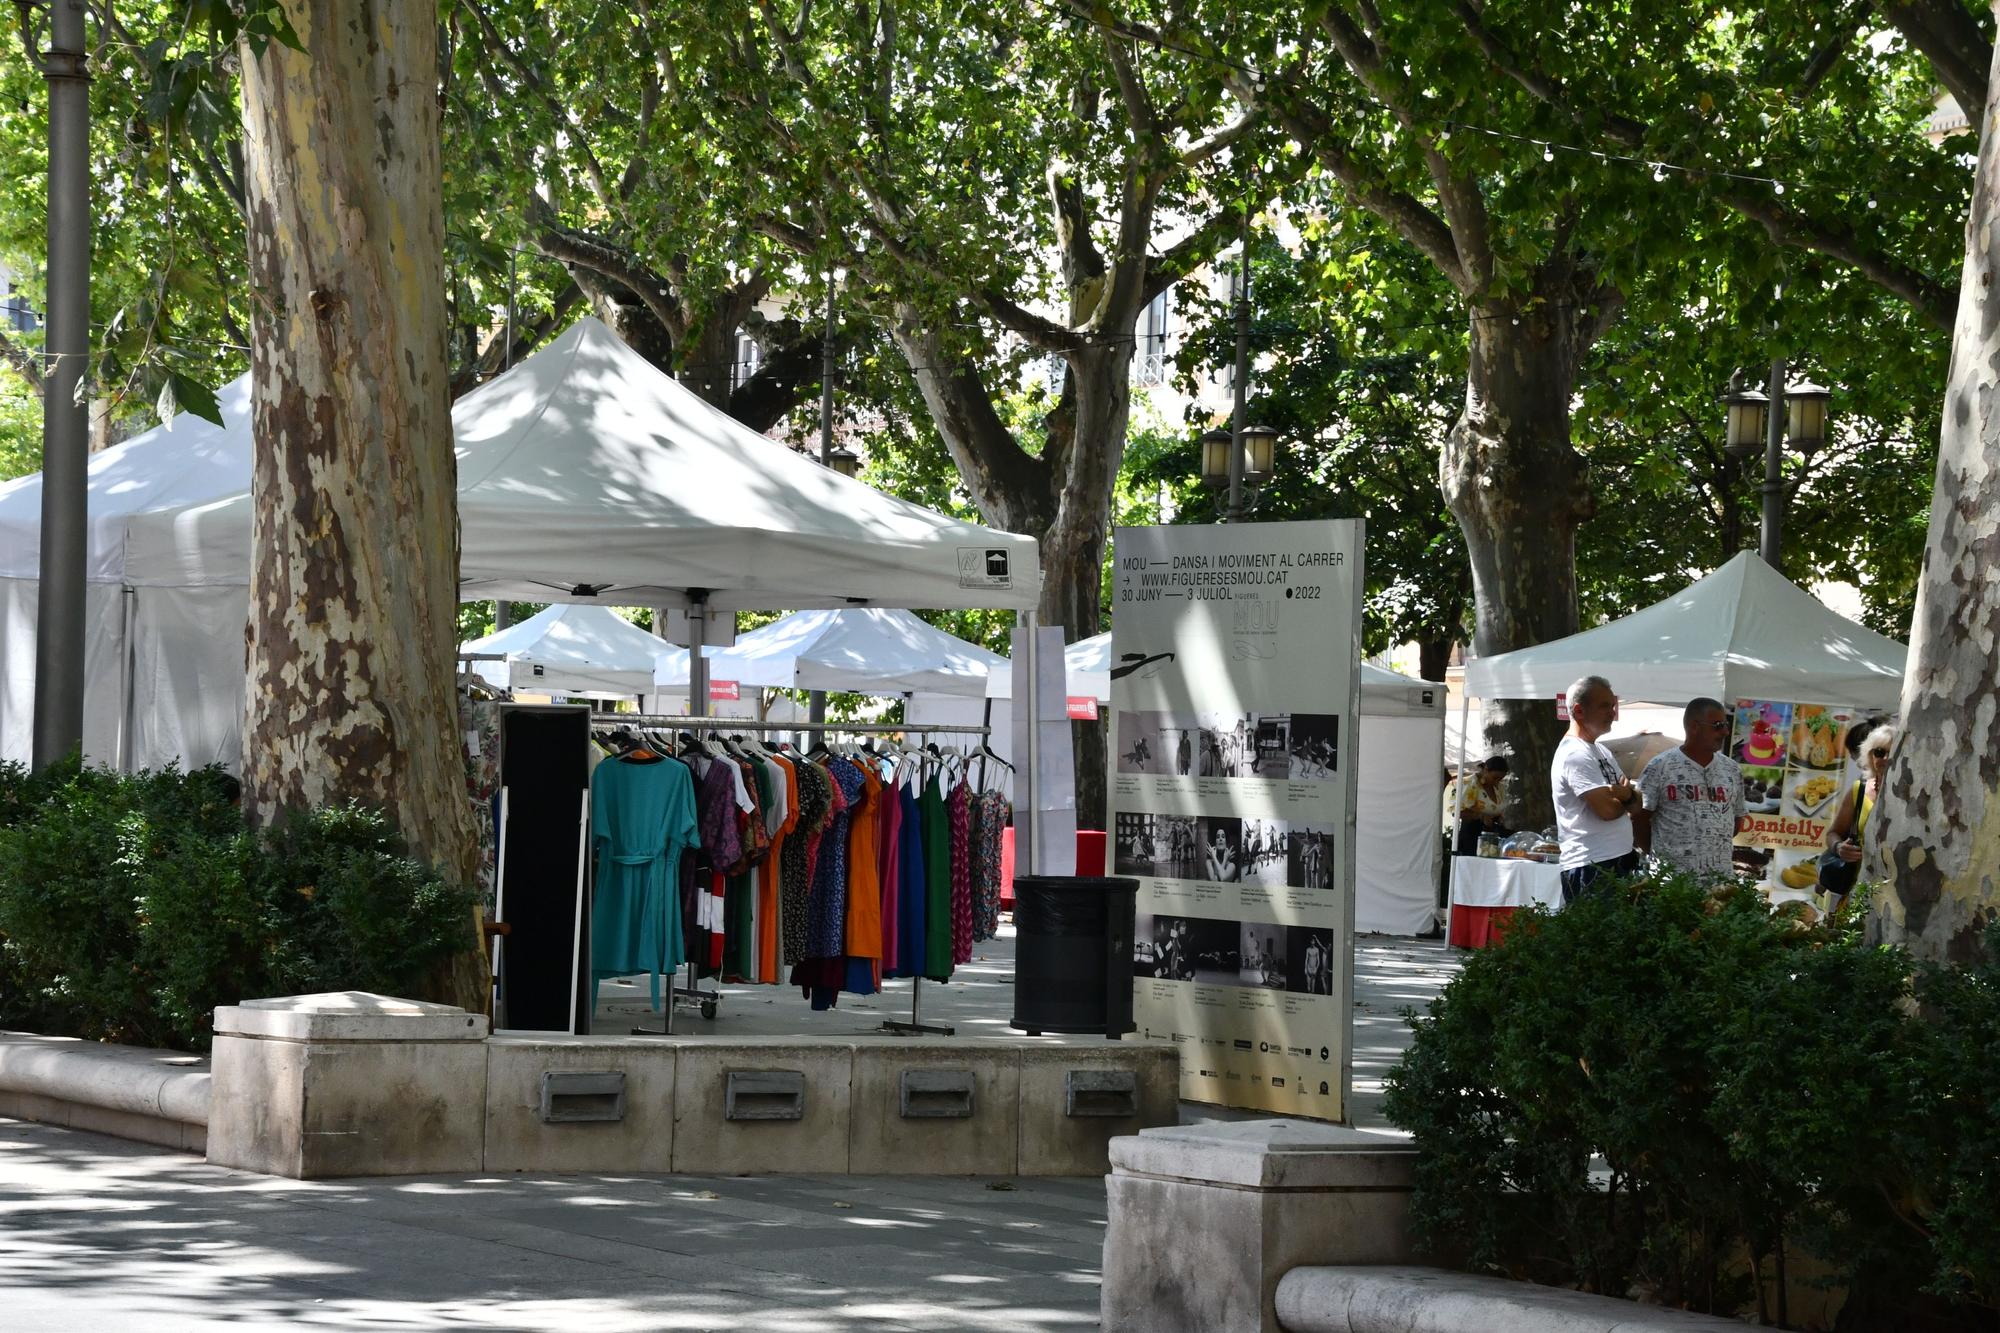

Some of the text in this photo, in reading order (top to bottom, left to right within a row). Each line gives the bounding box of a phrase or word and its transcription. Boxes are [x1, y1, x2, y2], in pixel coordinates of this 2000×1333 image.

[1122, 556, 1147, 571] MOU
[1173, 555, 1209, 570] DANSA
[1218, 553, 1277, 569] MOVIMENT
[1279, 552, 1294, 568] AL
[1297, 552, 1344, 568] CARRER
[1141, 570, 1289, 587] WWW.FIGUERESESMOU.CAT
[1121, 585, 1321, 602] 30 JUNY 3 JULIOL 2022
[1667, 783, 1729, 803] DSIUA
[1738, 814, 1825, 841] Danielly
[1784, 838, 1791, 847] y
